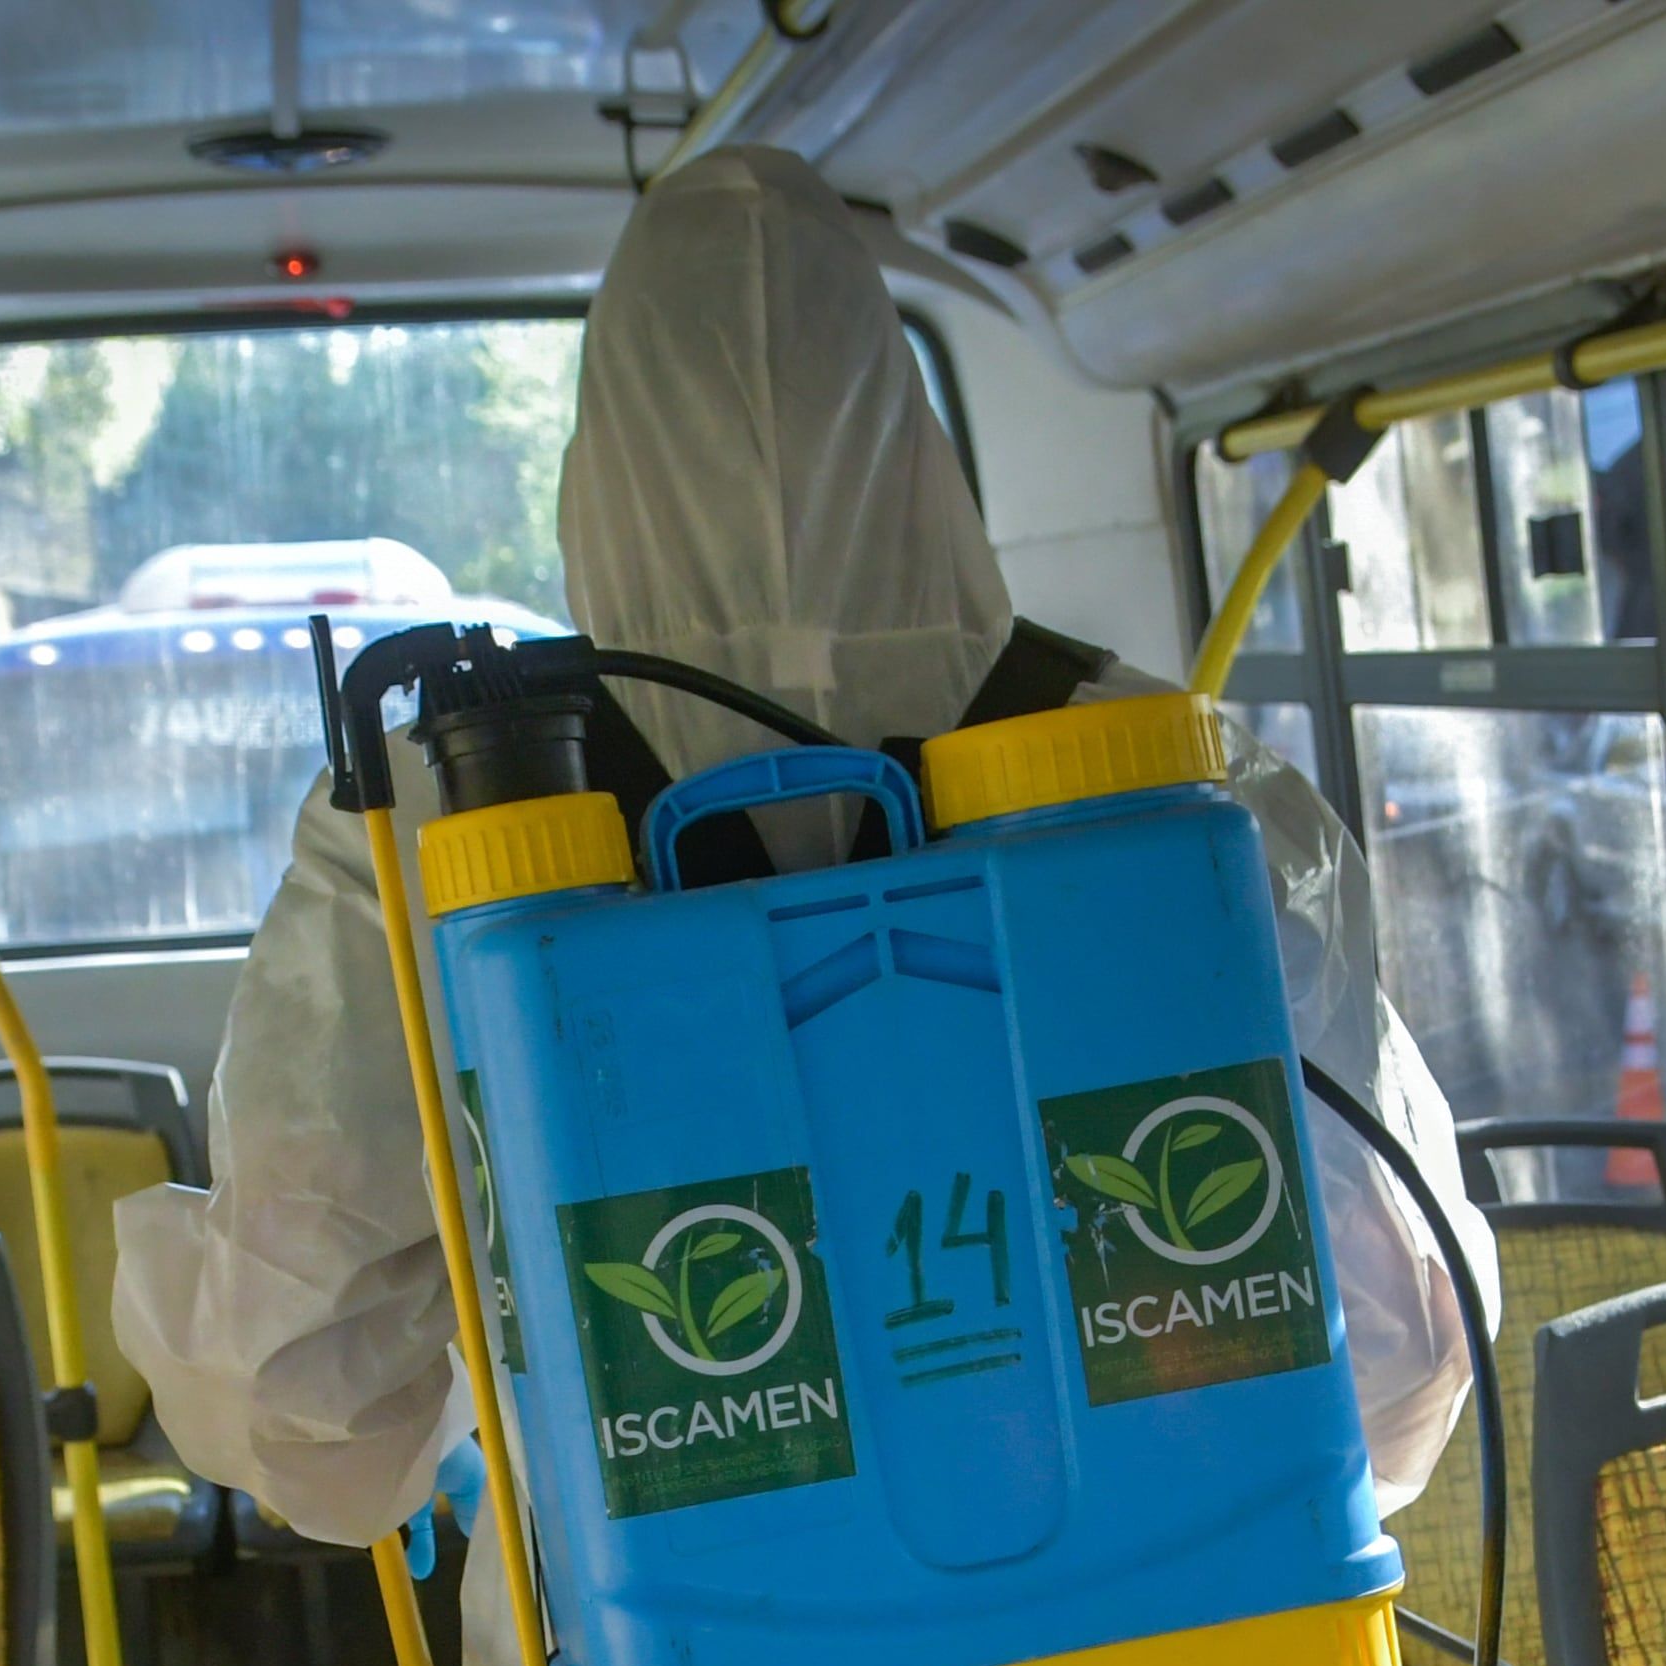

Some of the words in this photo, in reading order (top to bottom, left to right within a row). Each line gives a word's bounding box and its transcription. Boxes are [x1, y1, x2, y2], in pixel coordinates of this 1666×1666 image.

[884, 1170, 1012, 1331] 14
[1081, 1266, 1315, 1348] ISCAMEN
[601, 1377, 839, 1459] ISCAMEN
